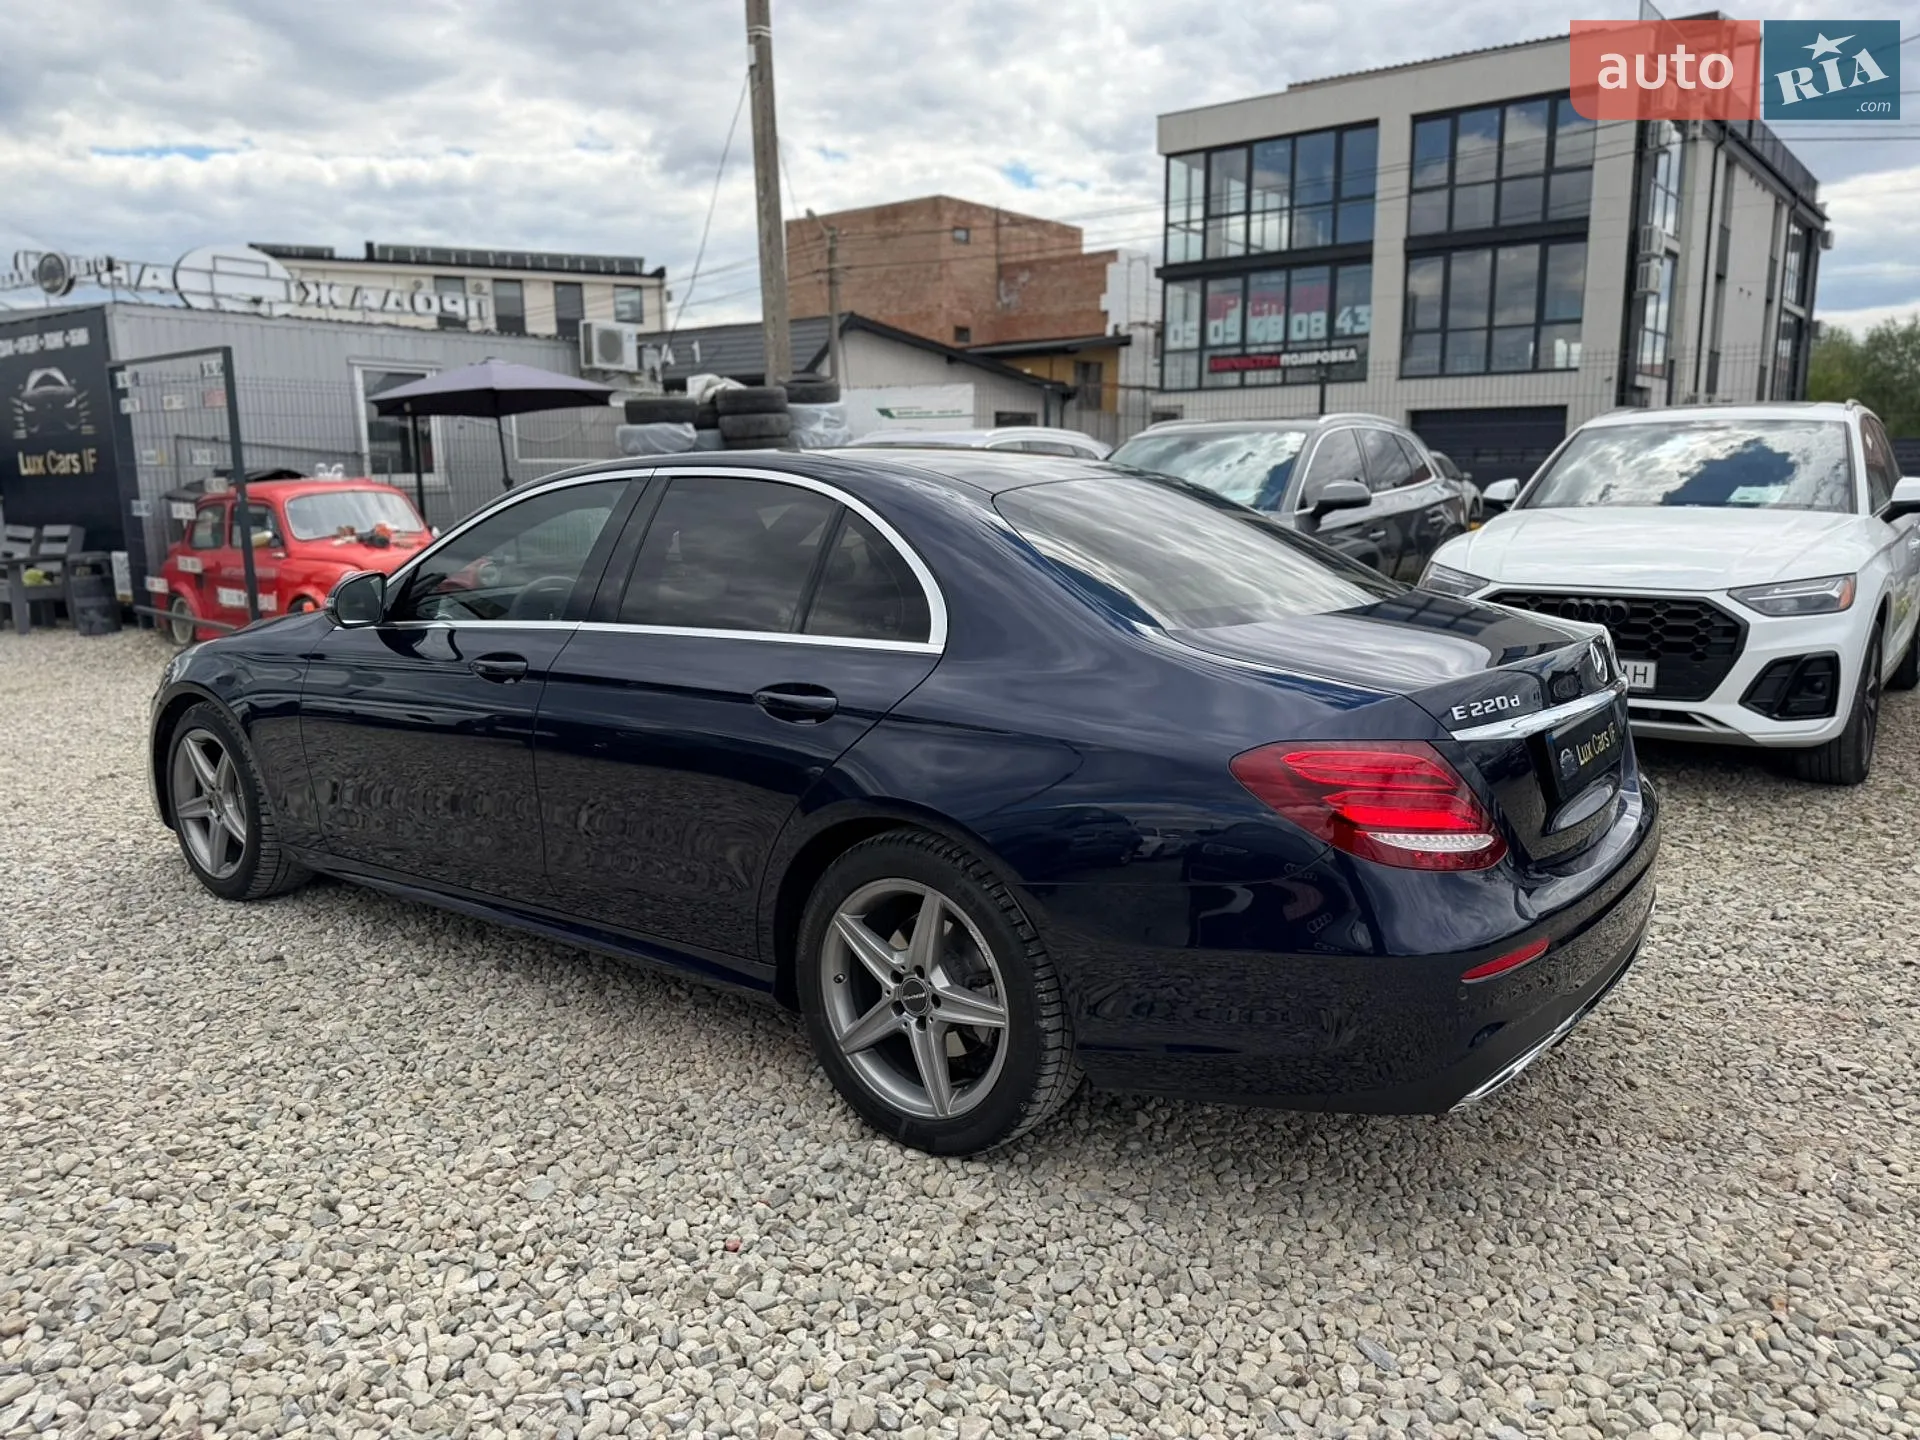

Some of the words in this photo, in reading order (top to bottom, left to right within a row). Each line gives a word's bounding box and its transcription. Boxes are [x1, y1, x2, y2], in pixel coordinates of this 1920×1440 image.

[1292, 311, 1327, 340] 08
[1336, 304, 1372, 335] 43
[17, 451, 46, 476] Lux
[46, 449, 81, 475] Cars
[82, 447, 97, 474] IF
[1451, 705, 1468, 720] E
[1469, 694, 1520, 717] 220d
[1575, 742, 1594, 766] Lux
[1592, 731, 1610, 755] Cars
